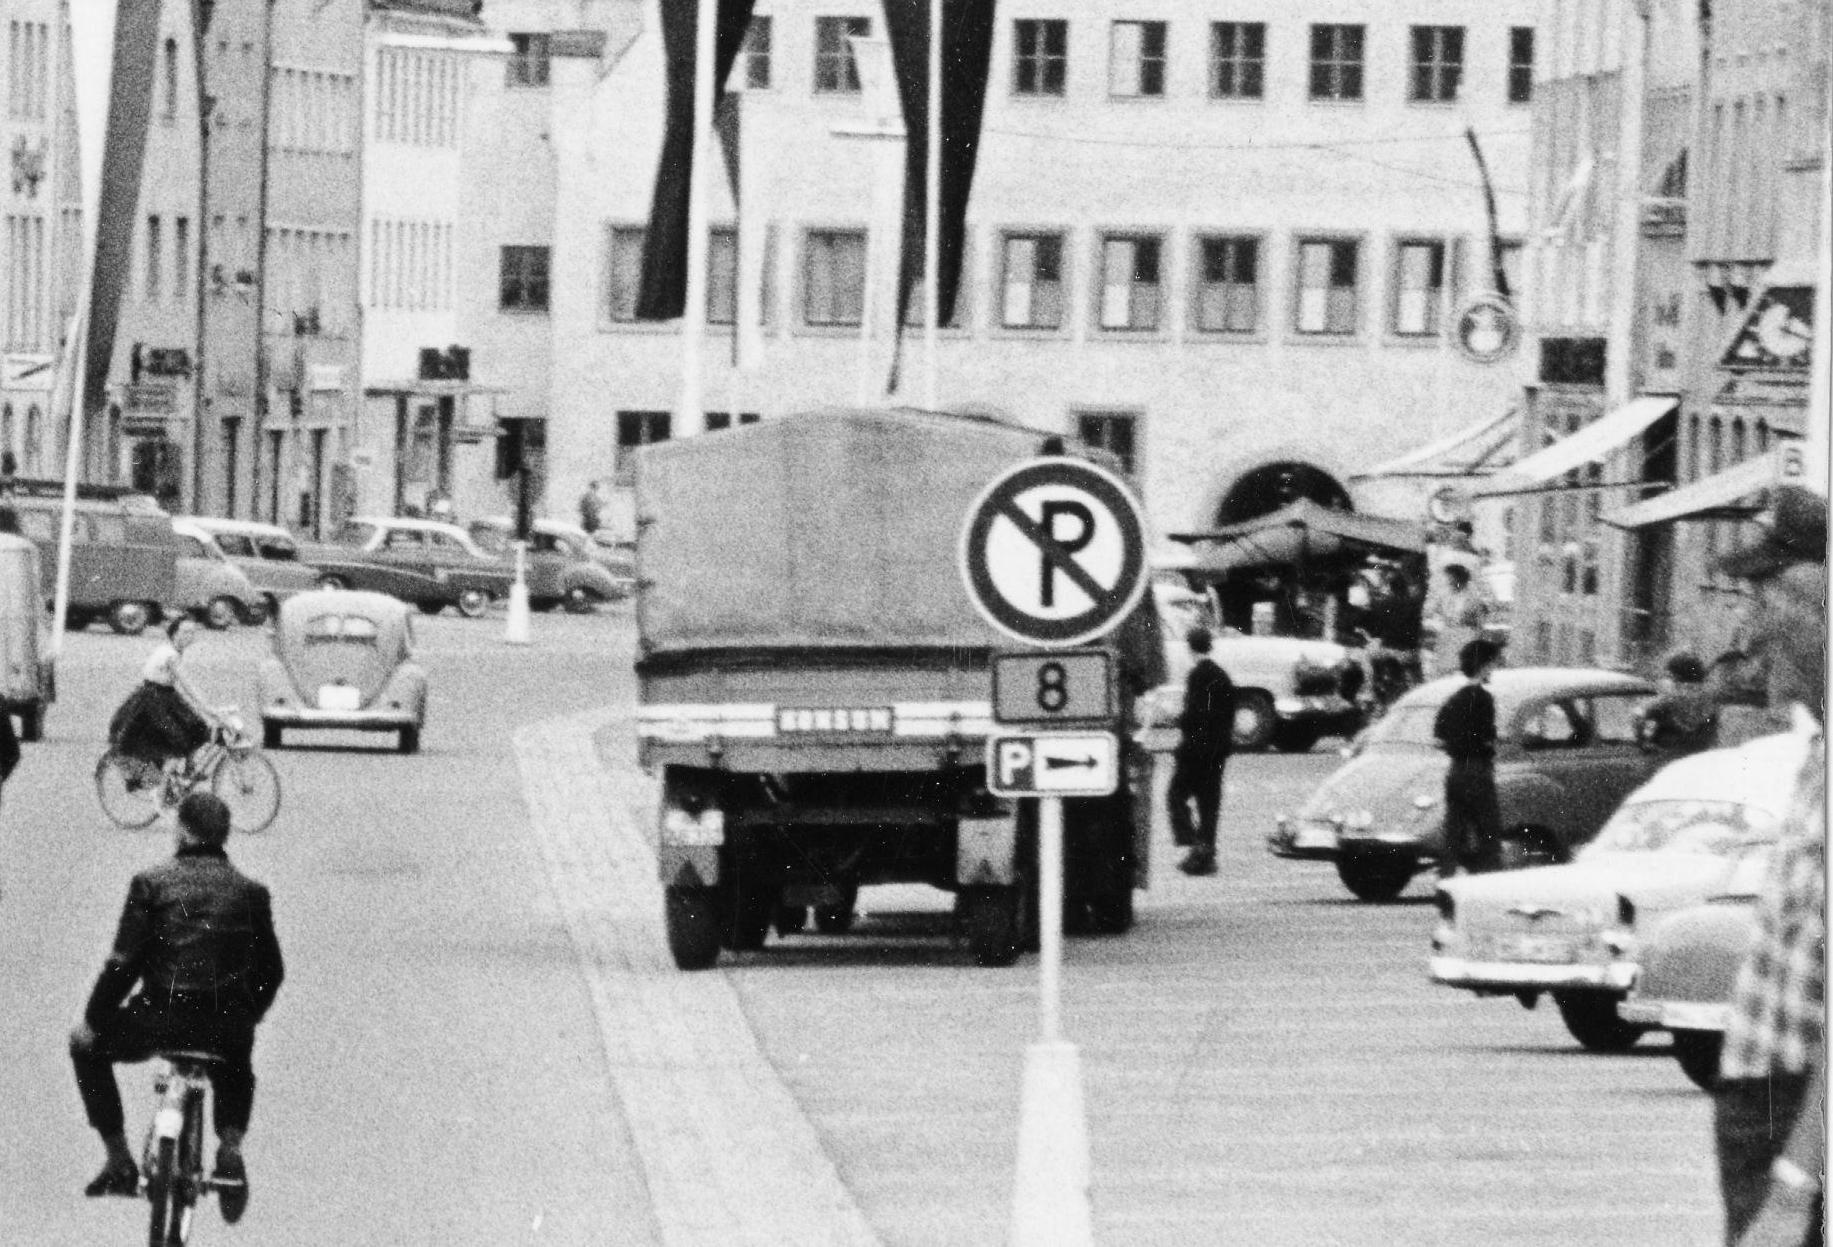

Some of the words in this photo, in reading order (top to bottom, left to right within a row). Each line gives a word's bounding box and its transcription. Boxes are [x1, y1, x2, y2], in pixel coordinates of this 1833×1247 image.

[1041, 500, 1095, 607] P
[1037, 661, 1067, 711] 8
[780, 709, 890, 731] KONSUM
[999, 742, 1032, 785] P
